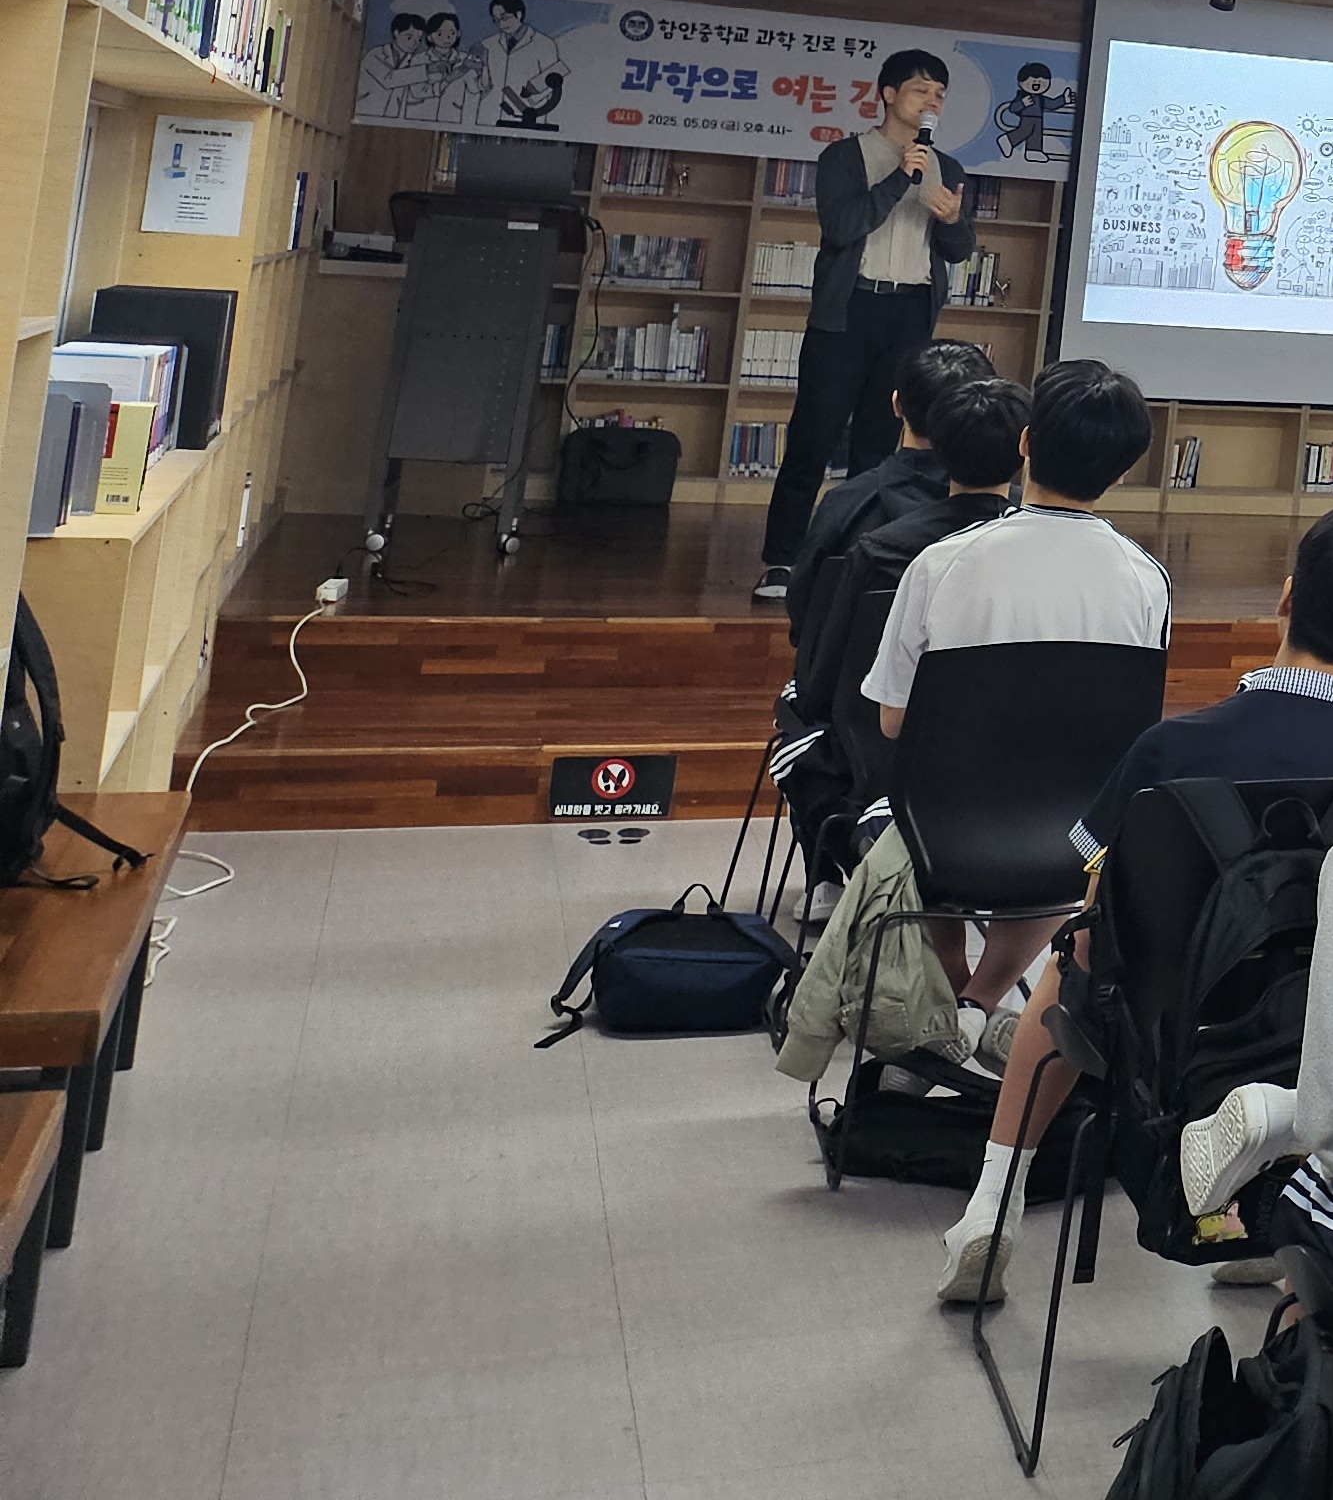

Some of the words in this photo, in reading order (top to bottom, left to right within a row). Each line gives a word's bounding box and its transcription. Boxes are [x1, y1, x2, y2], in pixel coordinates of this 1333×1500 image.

[658, 18, 749, 46] 함안중학교
[756, 28, 796, 51] 과학
[803, 33, 836, 53] 진로
[843, 38, 877, 58] 특강
[621, 58, 758, 104] 과학으로
[772, 75, 836, 114] 여는
[744, 122, 764, 133] 오후
[1102, 218, 1162, 233] BUSINESS
[1135, 235, 1161, 245] Idea
[554, 804, 592, 816] 실내화를
[594, 804, 611, 816] 벗고
